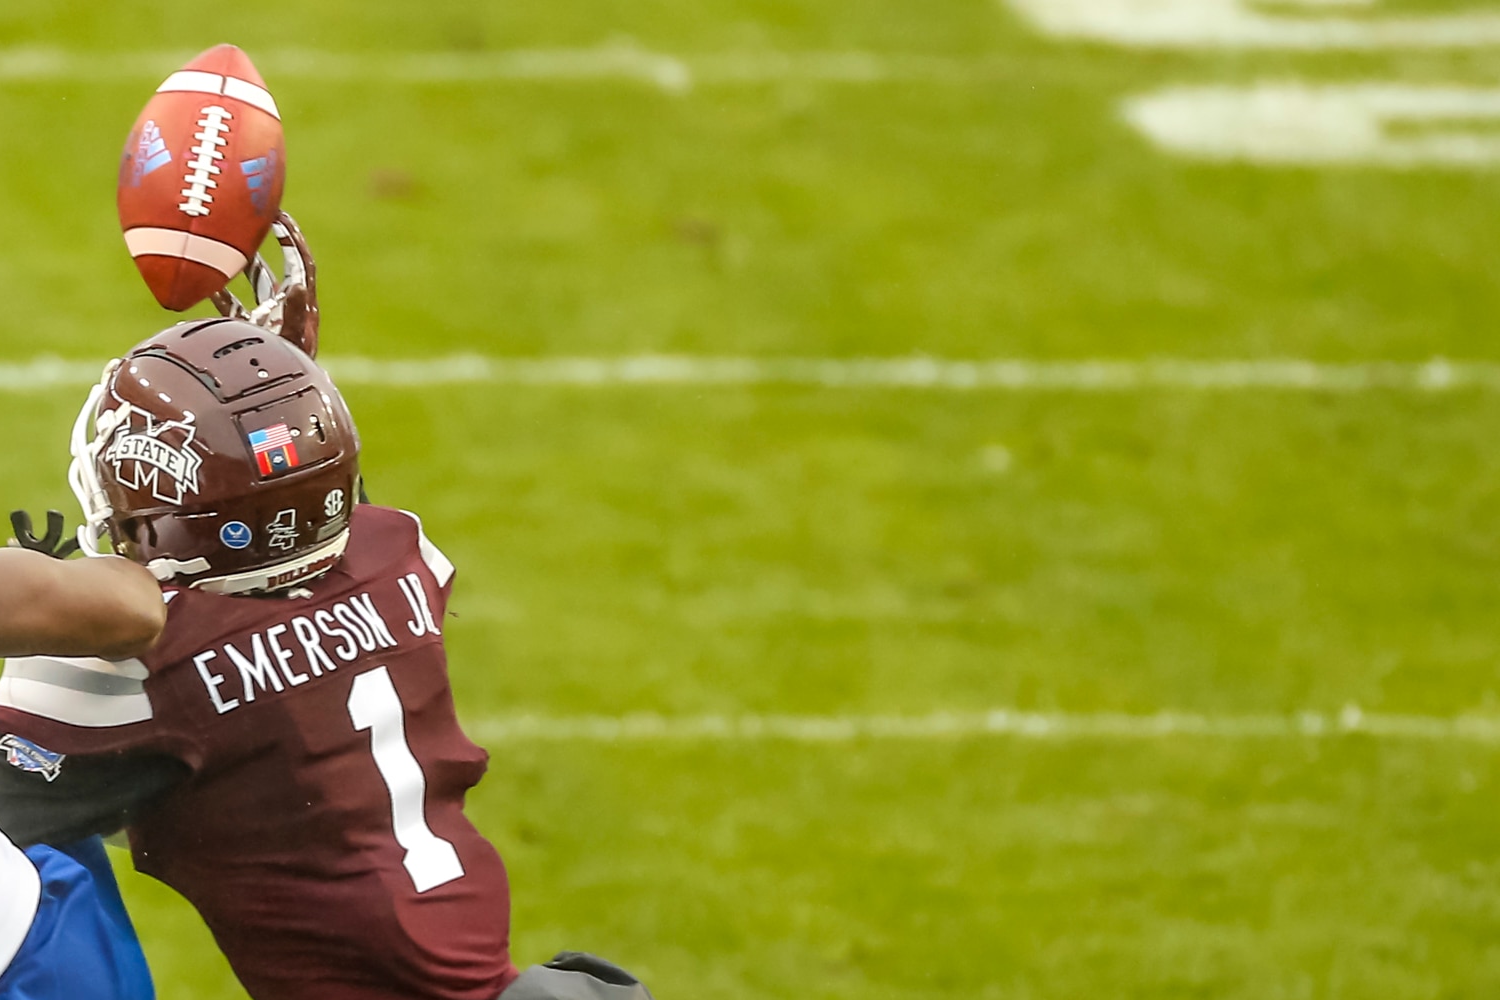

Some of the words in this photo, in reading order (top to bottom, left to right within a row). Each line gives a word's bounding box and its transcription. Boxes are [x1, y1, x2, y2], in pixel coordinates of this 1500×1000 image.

[119, 437, 180, 474] STATE
[193, 592, 398, 714] EMERSON
[346, 665, 466, 893] 1
